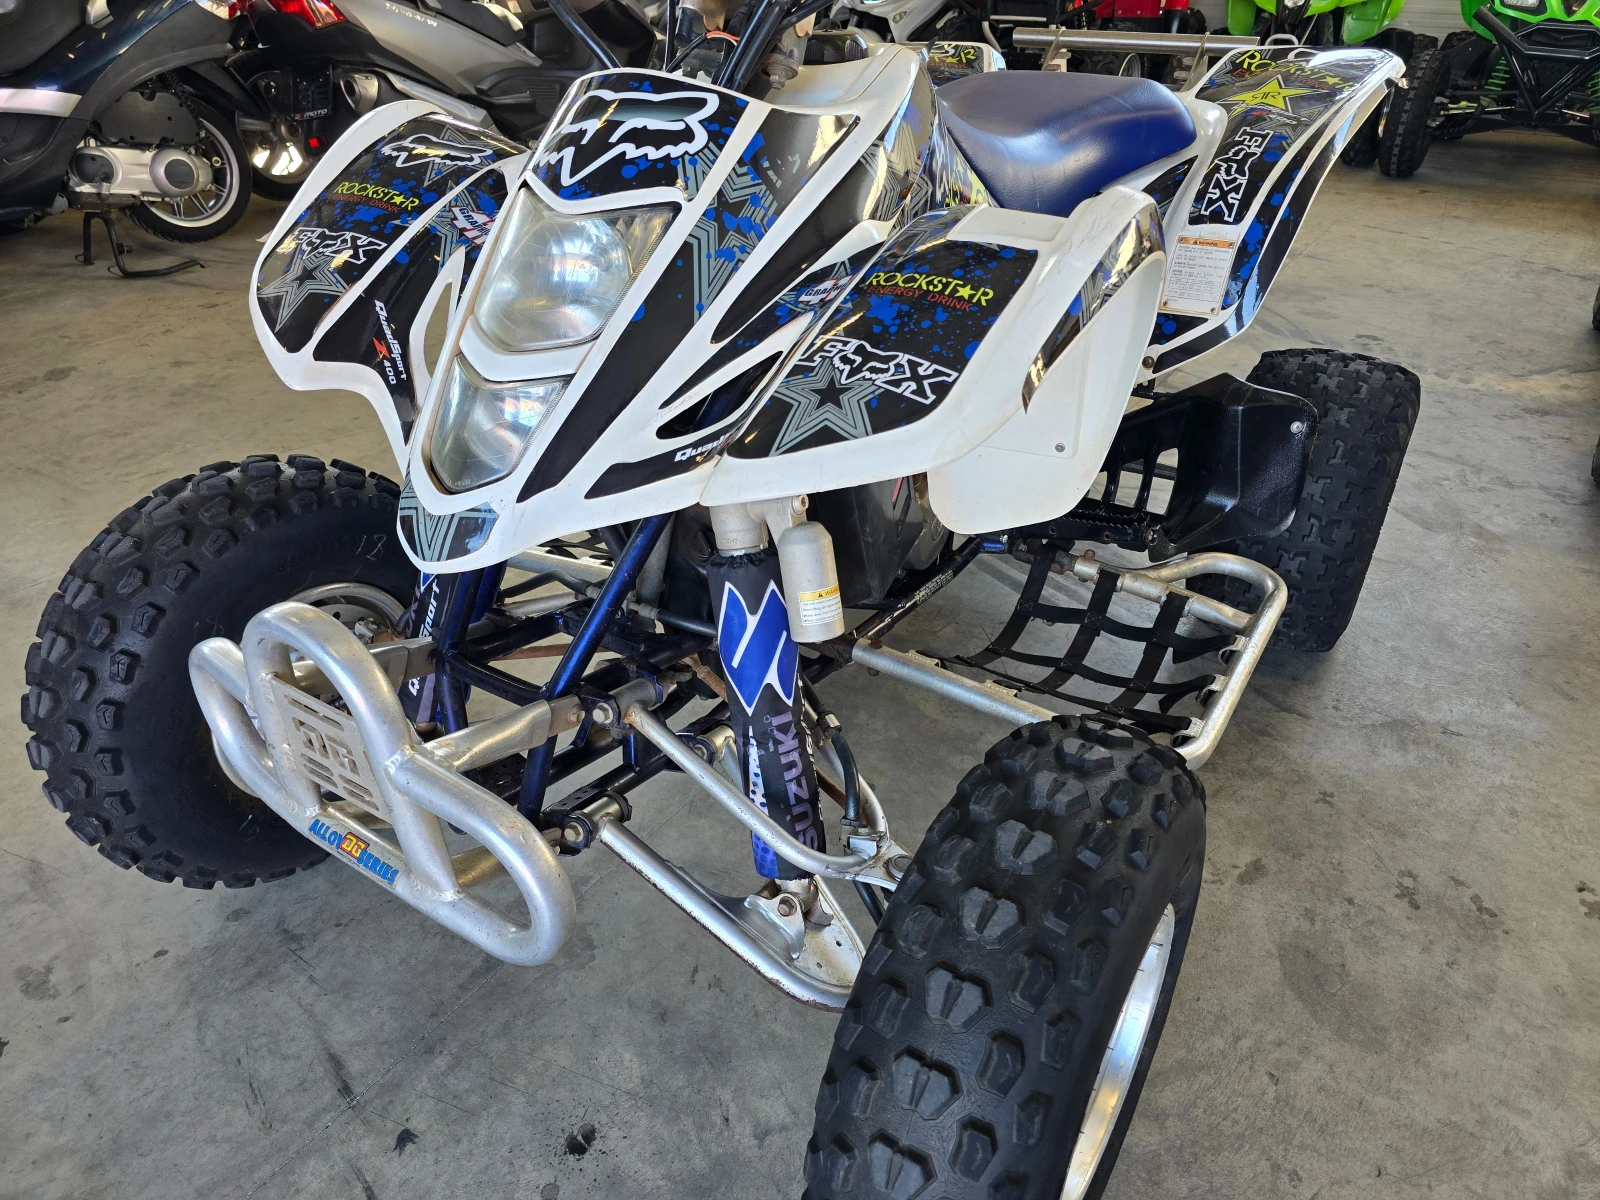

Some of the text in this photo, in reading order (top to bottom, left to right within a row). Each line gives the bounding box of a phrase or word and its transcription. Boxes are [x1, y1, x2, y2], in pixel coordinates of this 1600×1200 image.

[332, 194, 402, 213] ENERGY DRINK
[867, 285, 973, 311] ENERGY DRINK
[374, 299, 407, 381] QuadSport
[771, 711, 818, 853] SUZUKI
[357, 849, 399, 885] SERIES
